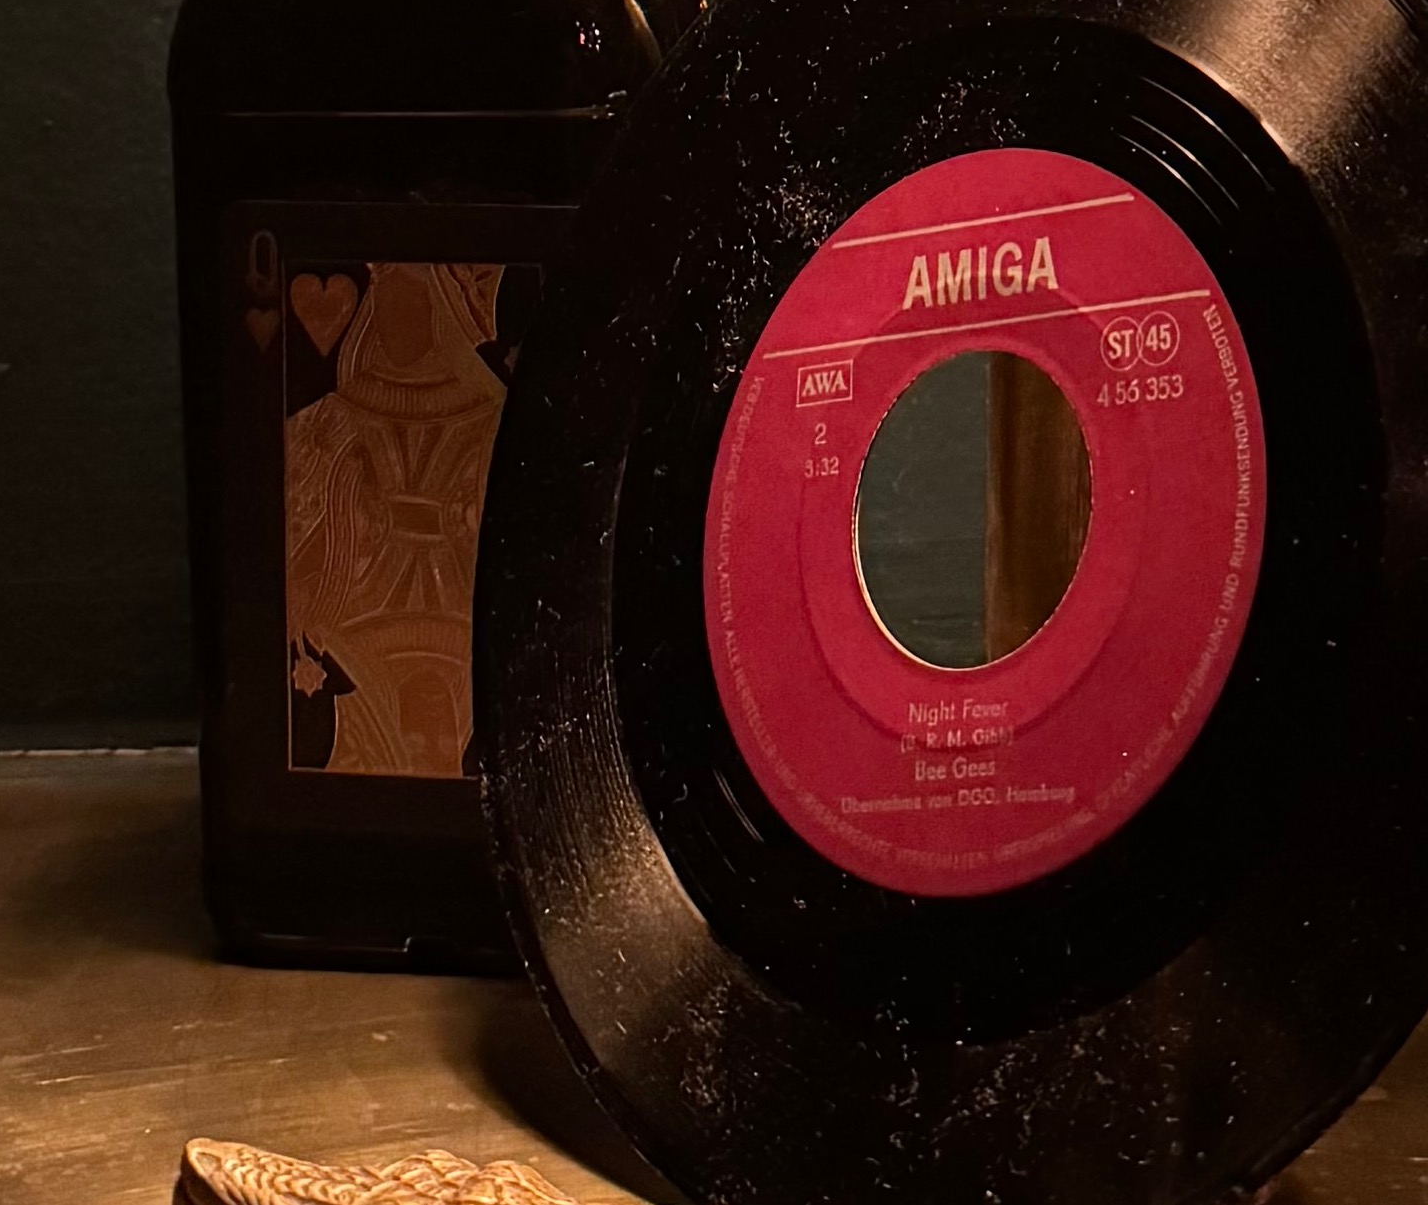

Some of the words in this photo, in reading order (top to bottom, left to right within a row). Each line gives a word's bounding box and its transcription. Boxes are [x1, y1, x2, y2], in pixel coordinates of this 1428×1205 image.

[902, 236, 1059, 310] AMIGA
[1107, 329, 1134, 360] ST
[1145, 323, 1171, 352] 45
[1200, 300, 1243, 390] VERBOTEN
[802, 370, 848, 396] AWA
[1145, 374, 1184, 401] 353
[814, 423, 827, 445] 2
[804, 456, 839, 478] 3:32
[1227, 388, 1252, 567] RUNDFUNKSENDUNG
[1218, 572, 1240, 612] UND
[908, 700, 955, 727] Night
[962, 698, 1009, 719] Fever
[914, 760, 947, 782] Bee
[952, 756, 996, 779] Gees
